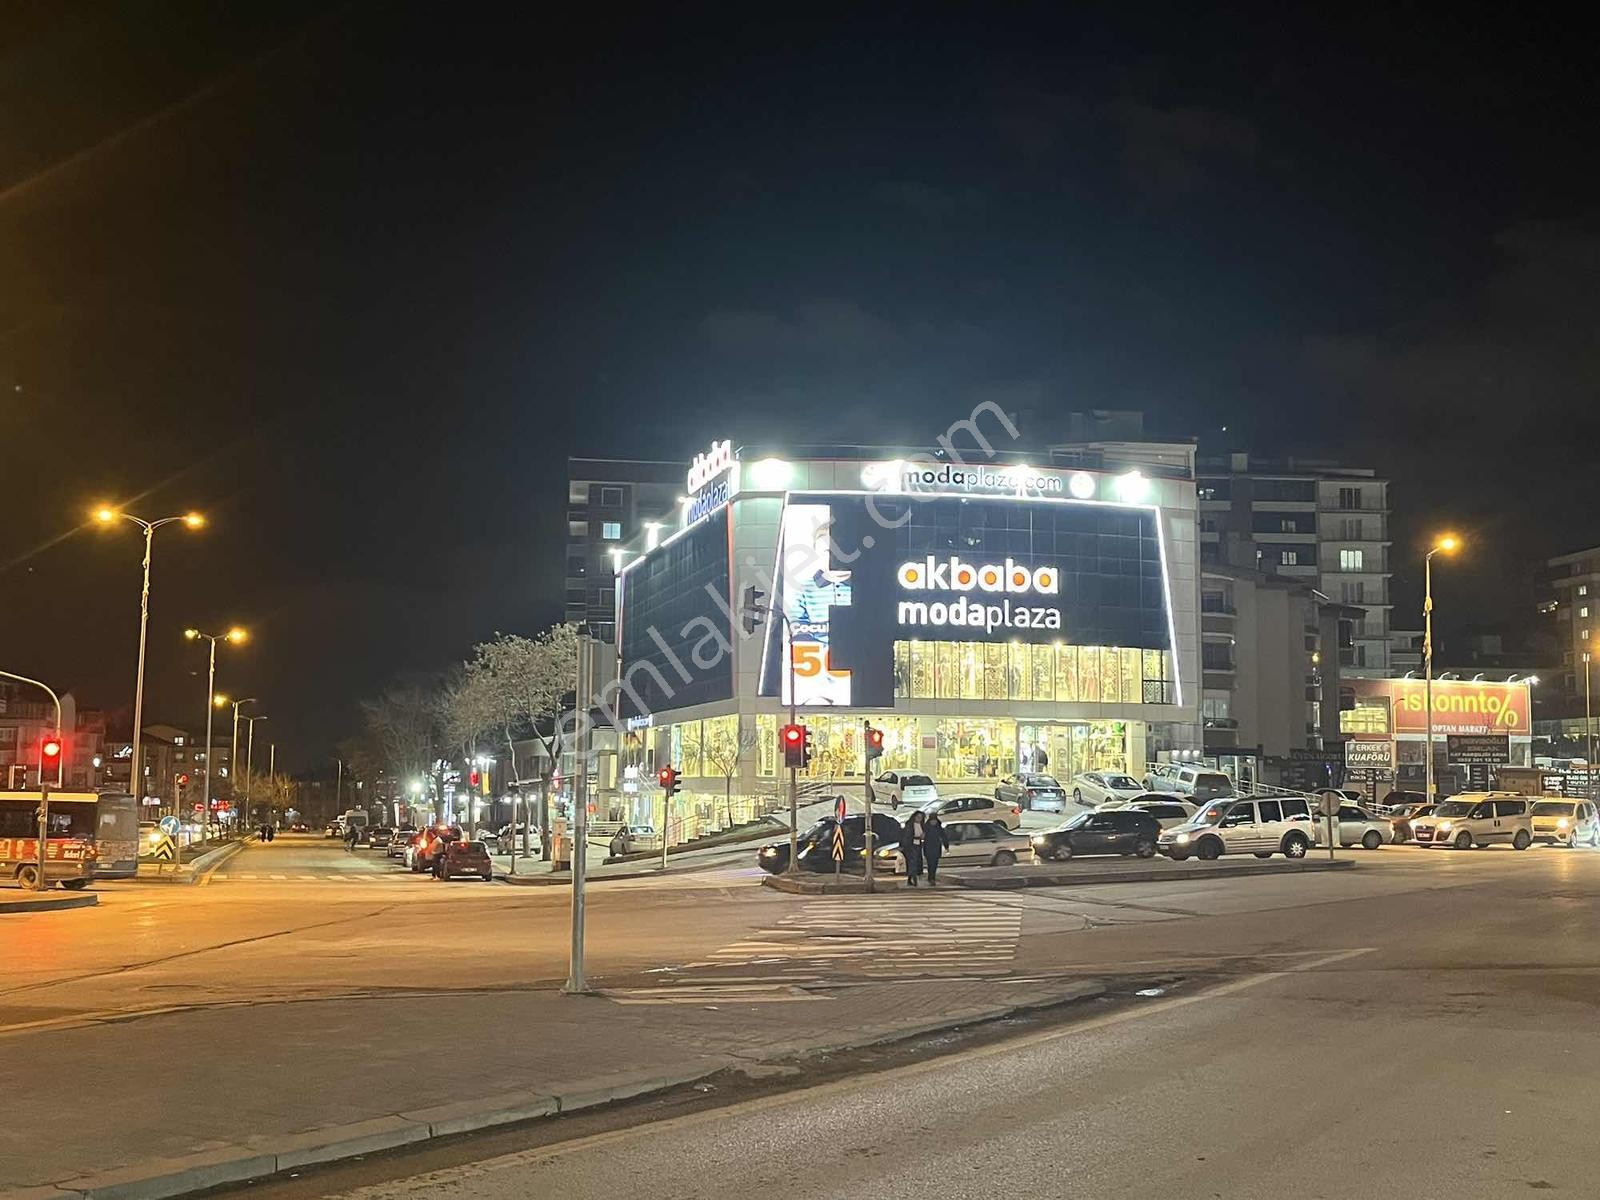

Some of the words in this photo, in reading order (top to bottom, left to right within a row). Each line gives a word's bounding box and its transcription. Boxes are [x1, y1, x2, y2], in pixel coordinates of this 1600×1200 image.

[897, 555, 1059, 594] akbaba
[898, 596, 1061, 634] modaplaza
[1432, 725, 1456, 733] OPTAN
[1348, 751, 1390, 762] KUAFÖRÜ
